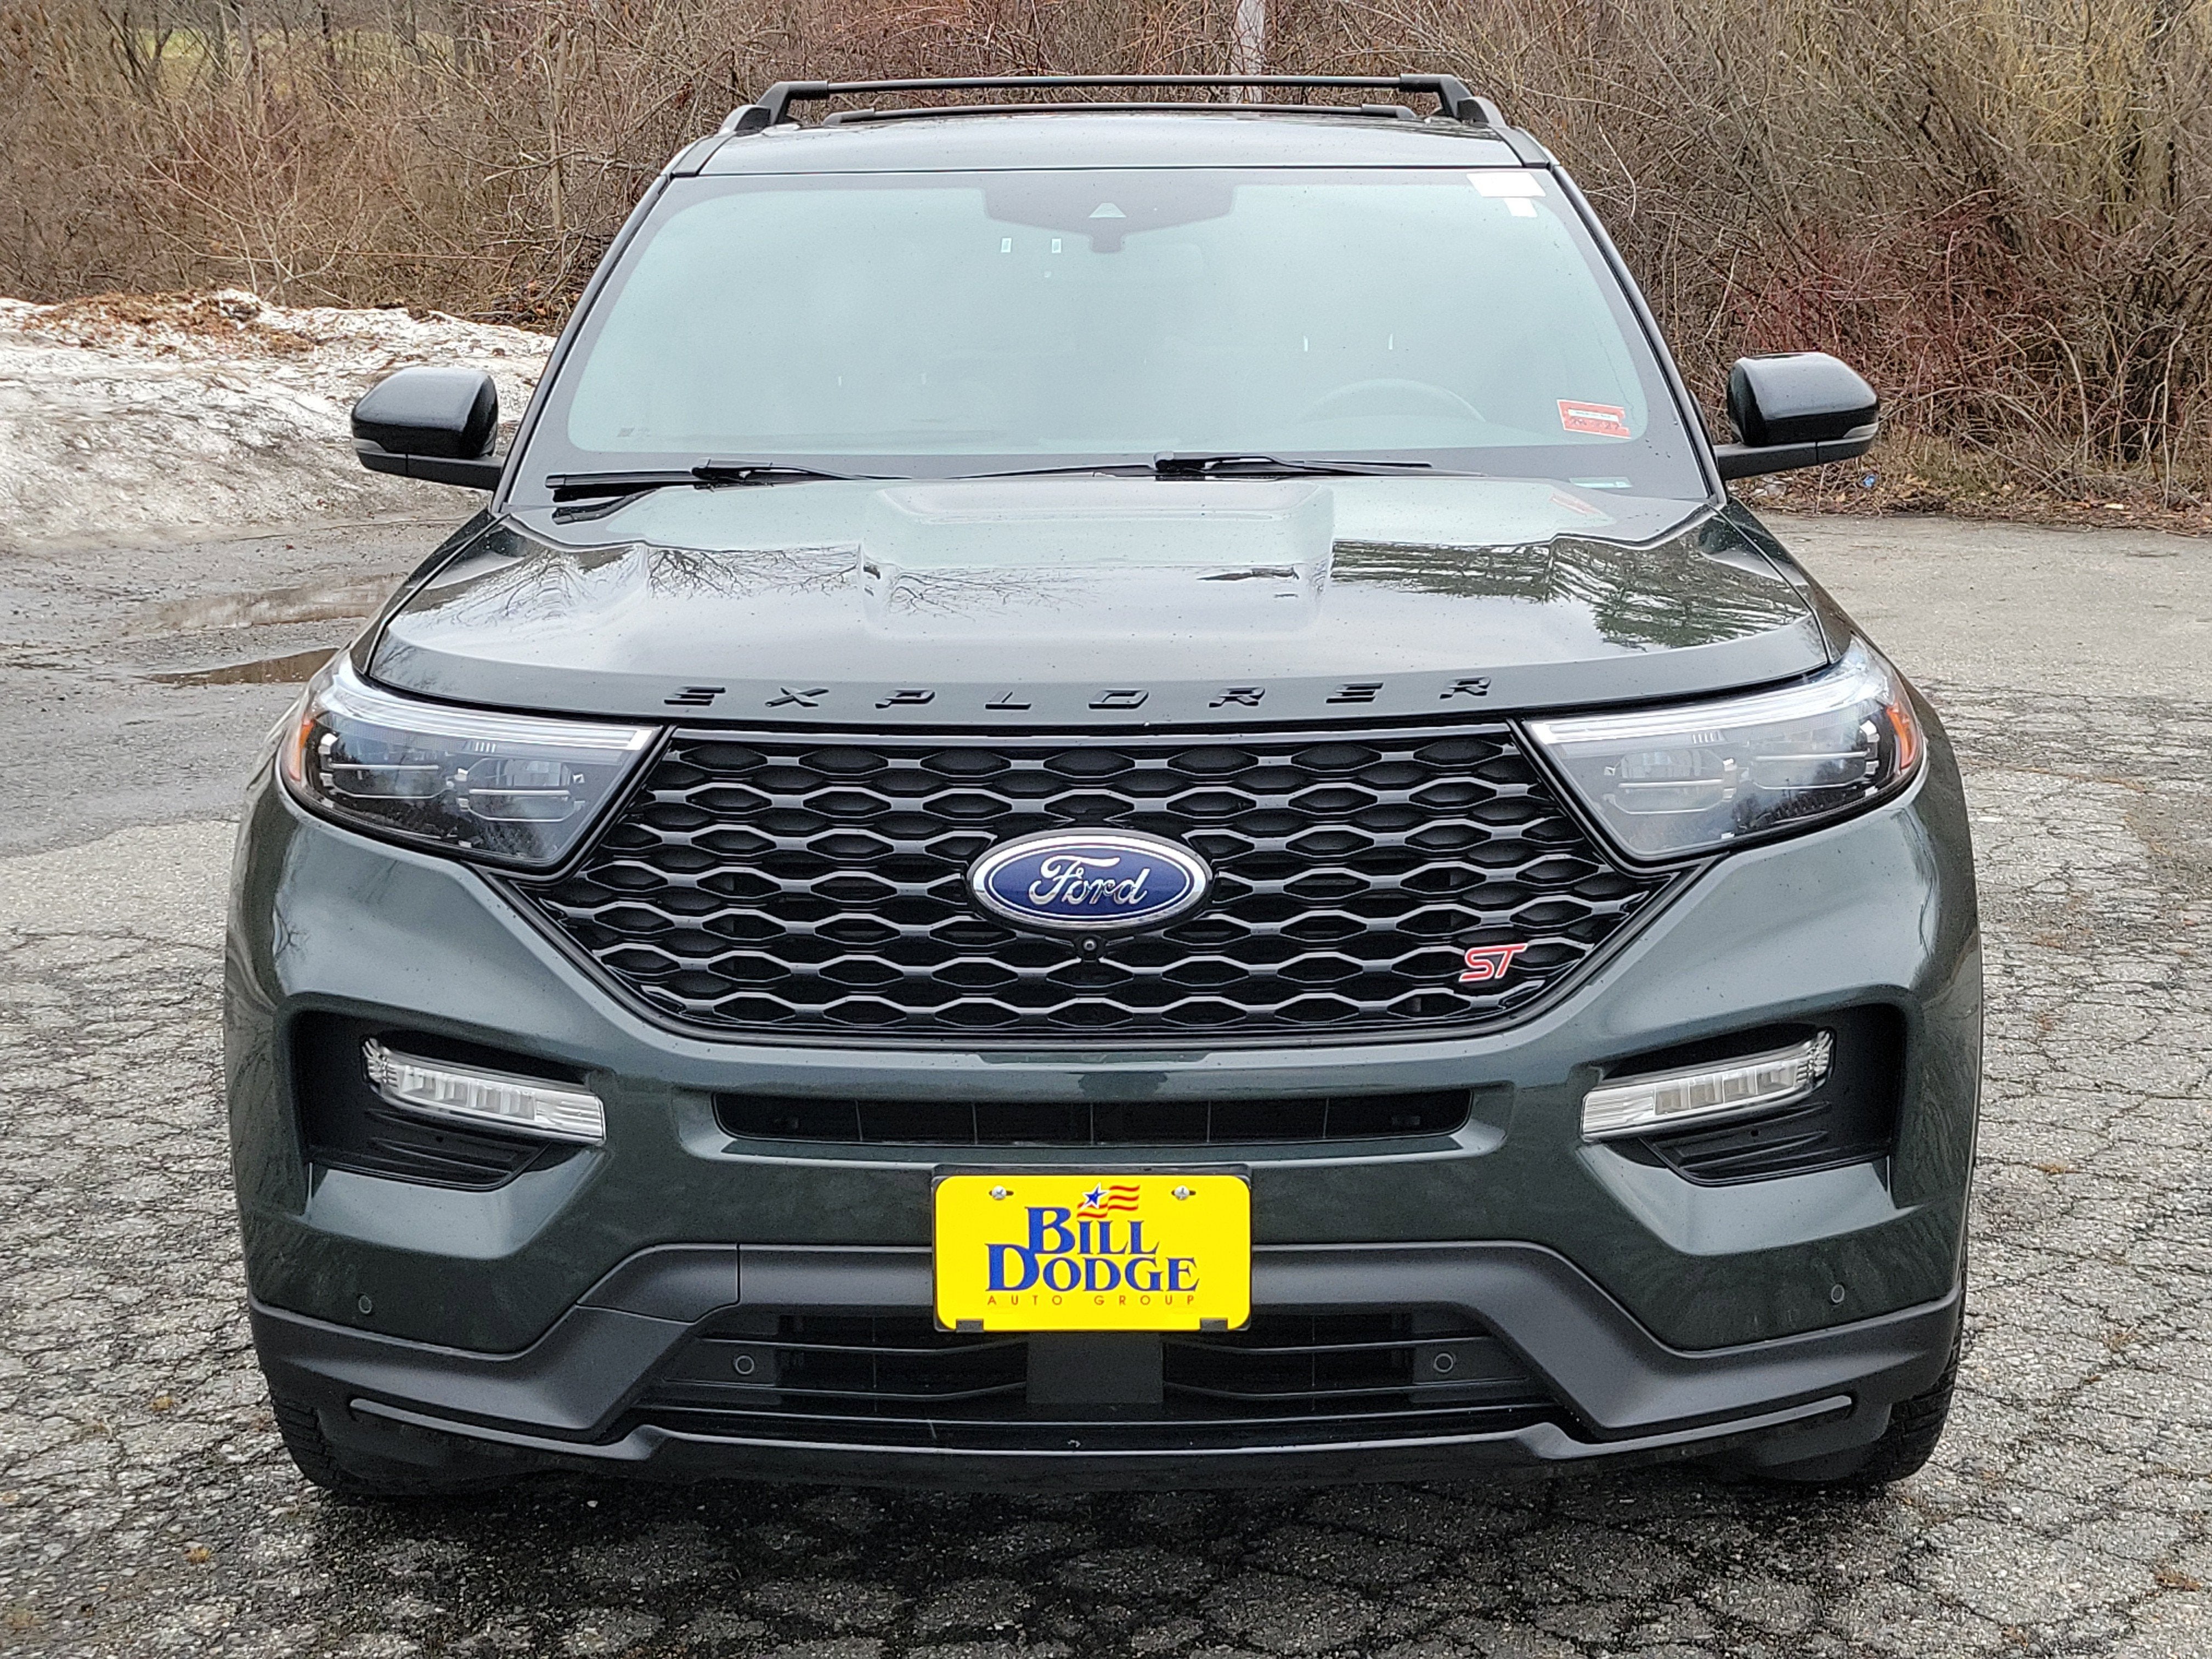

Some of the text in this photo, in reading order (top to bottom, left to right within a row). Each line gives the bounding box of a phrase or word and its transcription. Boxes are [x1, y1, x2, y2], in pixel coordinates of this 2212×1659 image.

[664, 676, 1492, 709] EXPLORER
[1028, 855, 1150, 905] Ford
[1458, 943, 1528, 982] ST
[1025, 1206, 1159, 1255] BILL
[985, 1242, 1199, 1291] DODGE
[988, 1294, 1195, 1306] AUTO GROUP
